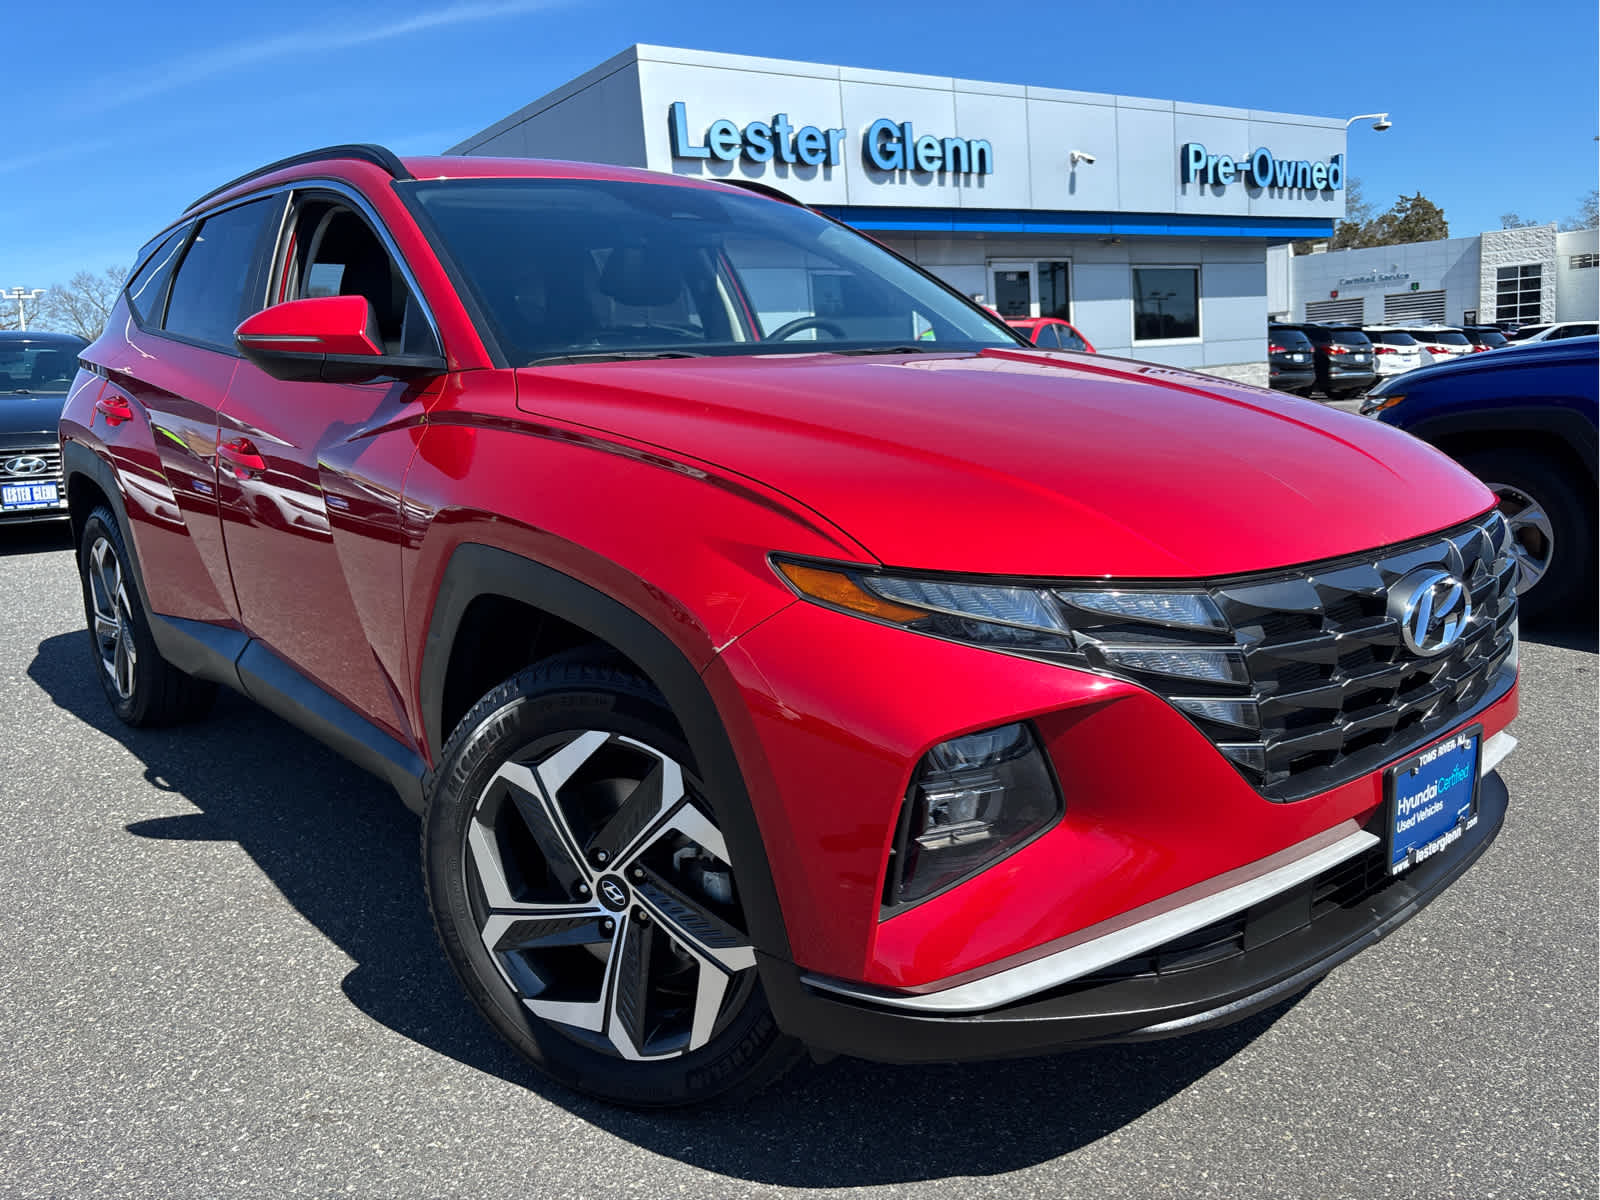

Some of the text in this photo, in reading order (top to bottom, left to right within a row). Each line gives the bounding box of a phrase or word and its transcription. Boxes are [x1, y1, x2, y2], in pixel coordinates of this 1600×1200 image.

[669, 101, 993, 175] Lester Glenn
[1181, 142, 1344, 192] Pre-Owned
[3, 487, 31, 503] LESTER
[1396, 813, 1416, 833] Used
[1416, 801, 1444, 824] Vehicles
